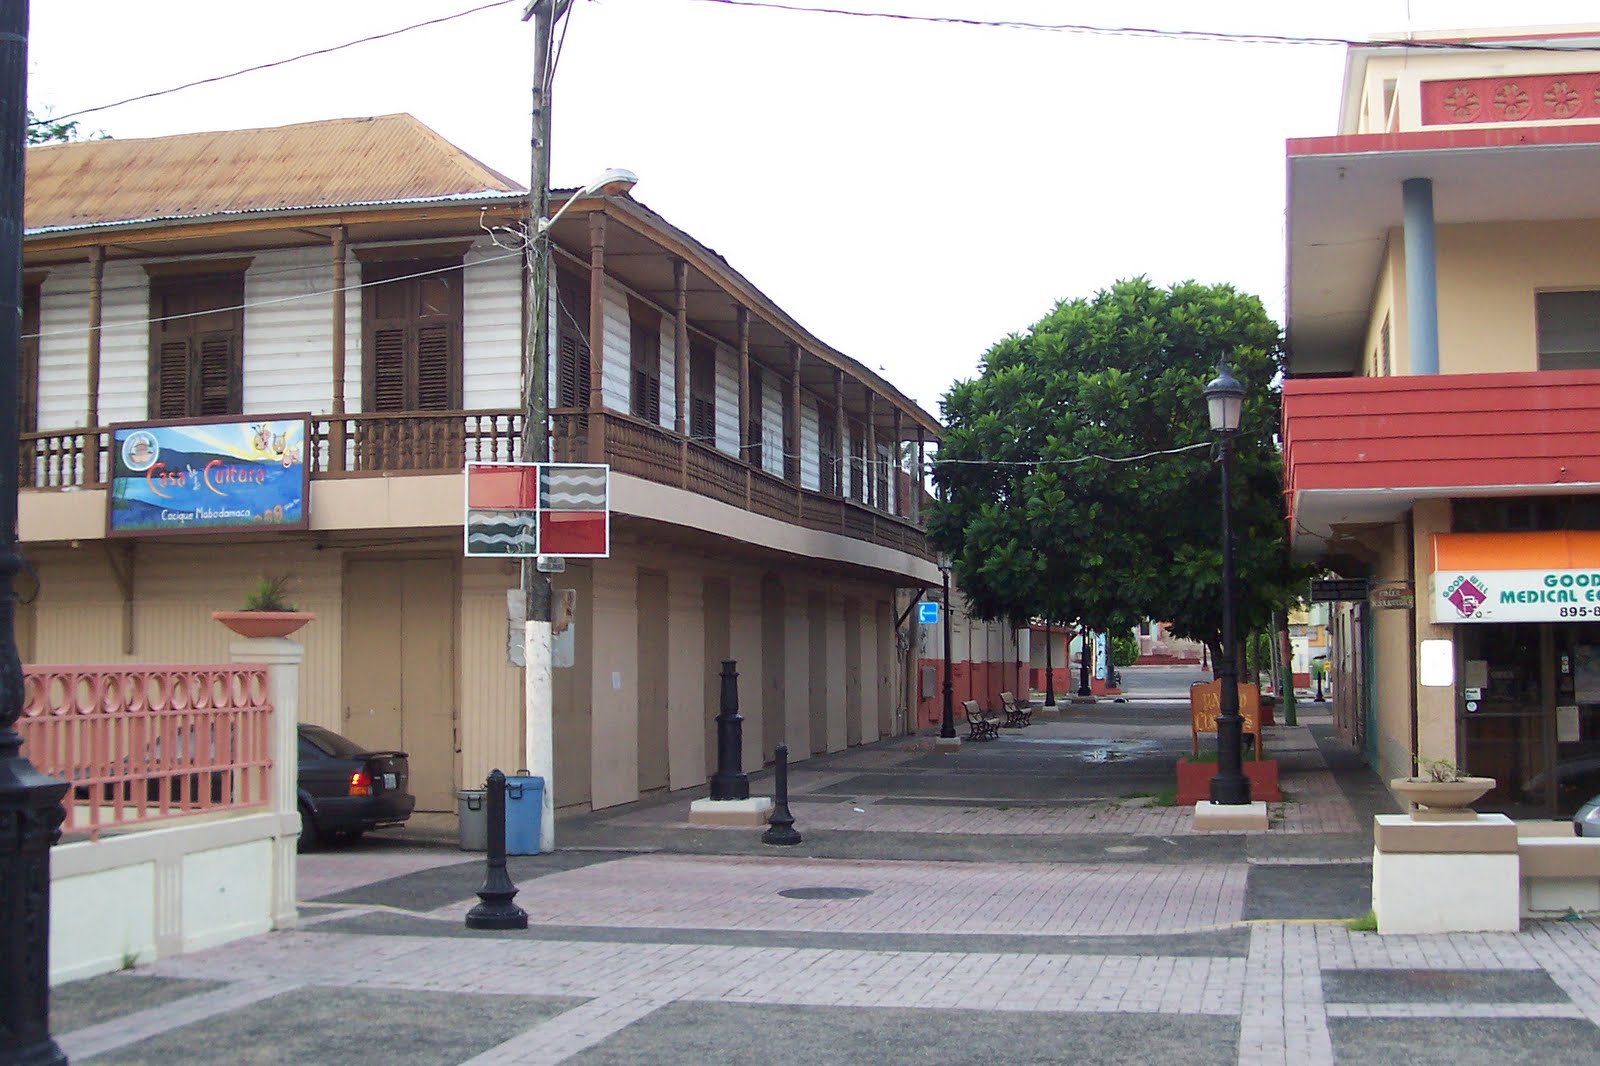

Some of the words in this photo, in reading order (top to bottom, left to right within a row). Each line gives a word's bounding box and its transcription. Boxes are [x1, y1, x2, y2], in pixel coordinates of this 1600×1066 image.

[146, 462, 186, 499] Casa
[204, 459, 265, 497] Cultura
[161, 509, 193, 524] Cacique
[1442, 575, 1465, 598] GOOD
[1469, 575, 1489, 594] WILL
[1543, 573, 1600, 588] GOOD
[1500, 589, 1578, 603] MEDICAL
[1560, 606, 1600, 617] 895-8
